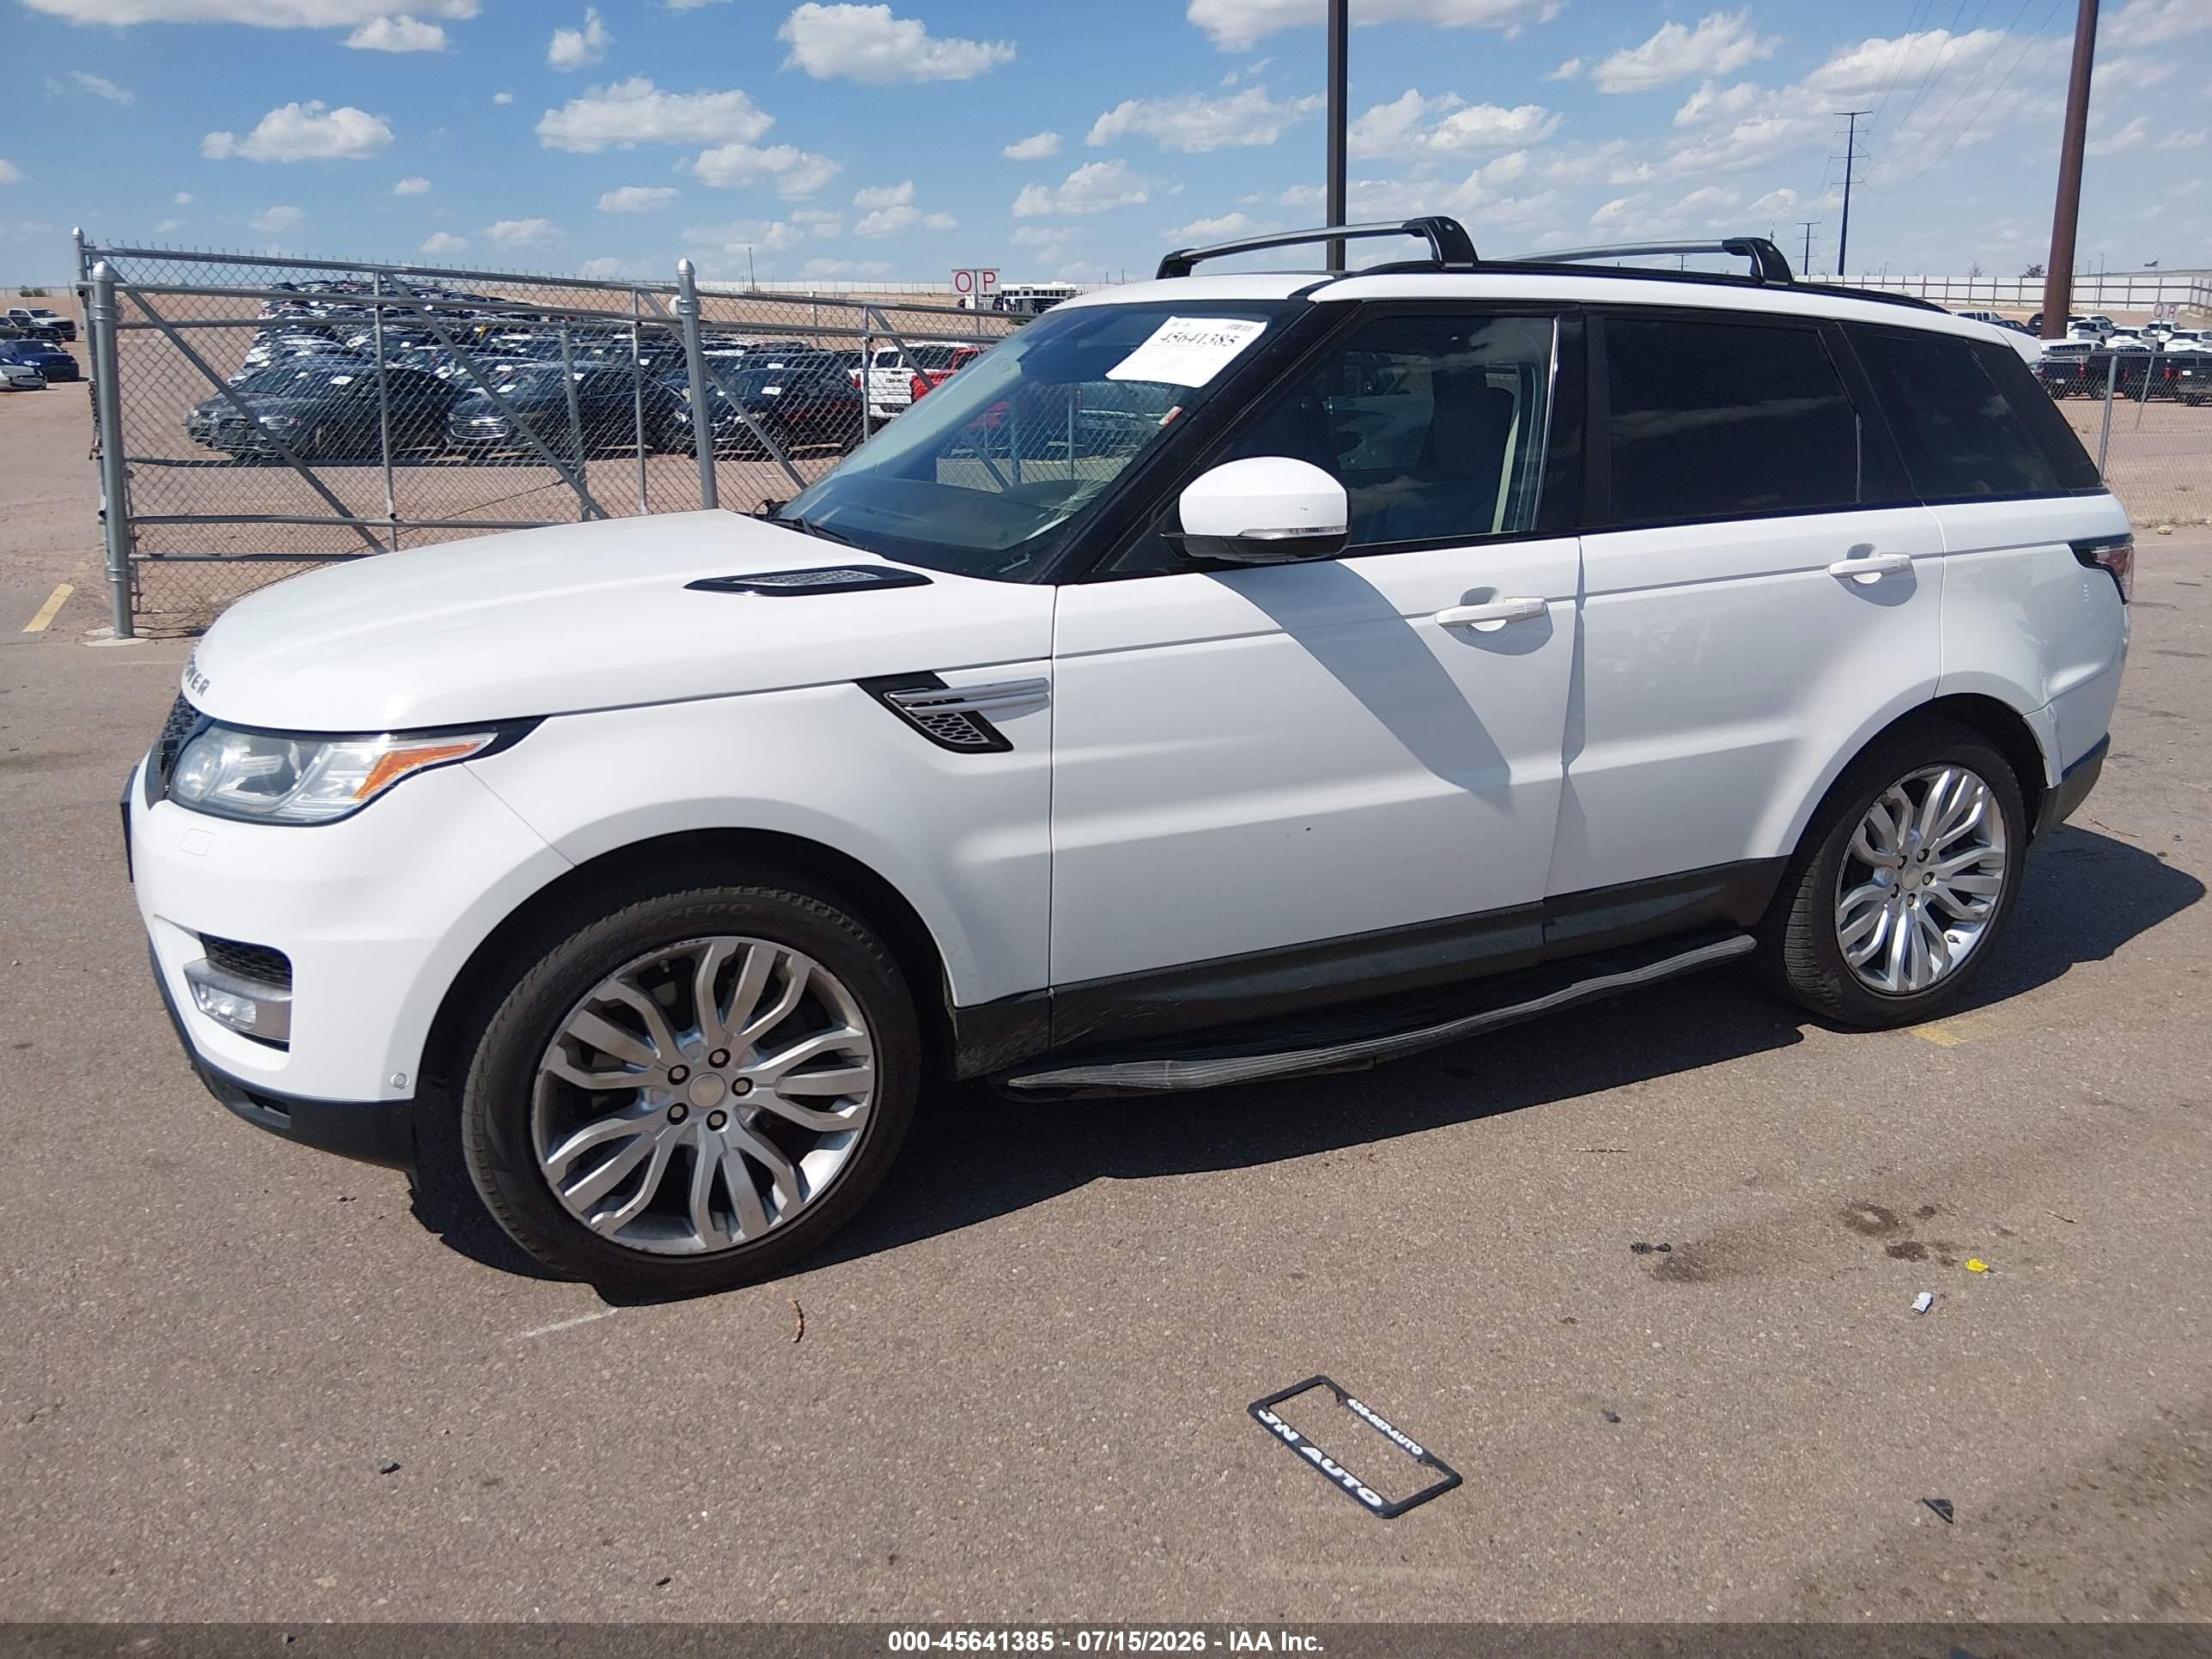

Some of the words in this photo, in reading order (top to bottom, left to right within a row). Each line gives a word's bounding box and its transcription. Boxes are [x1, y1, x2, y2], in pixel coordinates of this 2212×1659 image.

[955, 271, 972, 293] O
[982, 271, 996, 292] P
[1159, 331, 1242, 347] 45641385
[1299, 1446, 1382, 1507] AUTO
